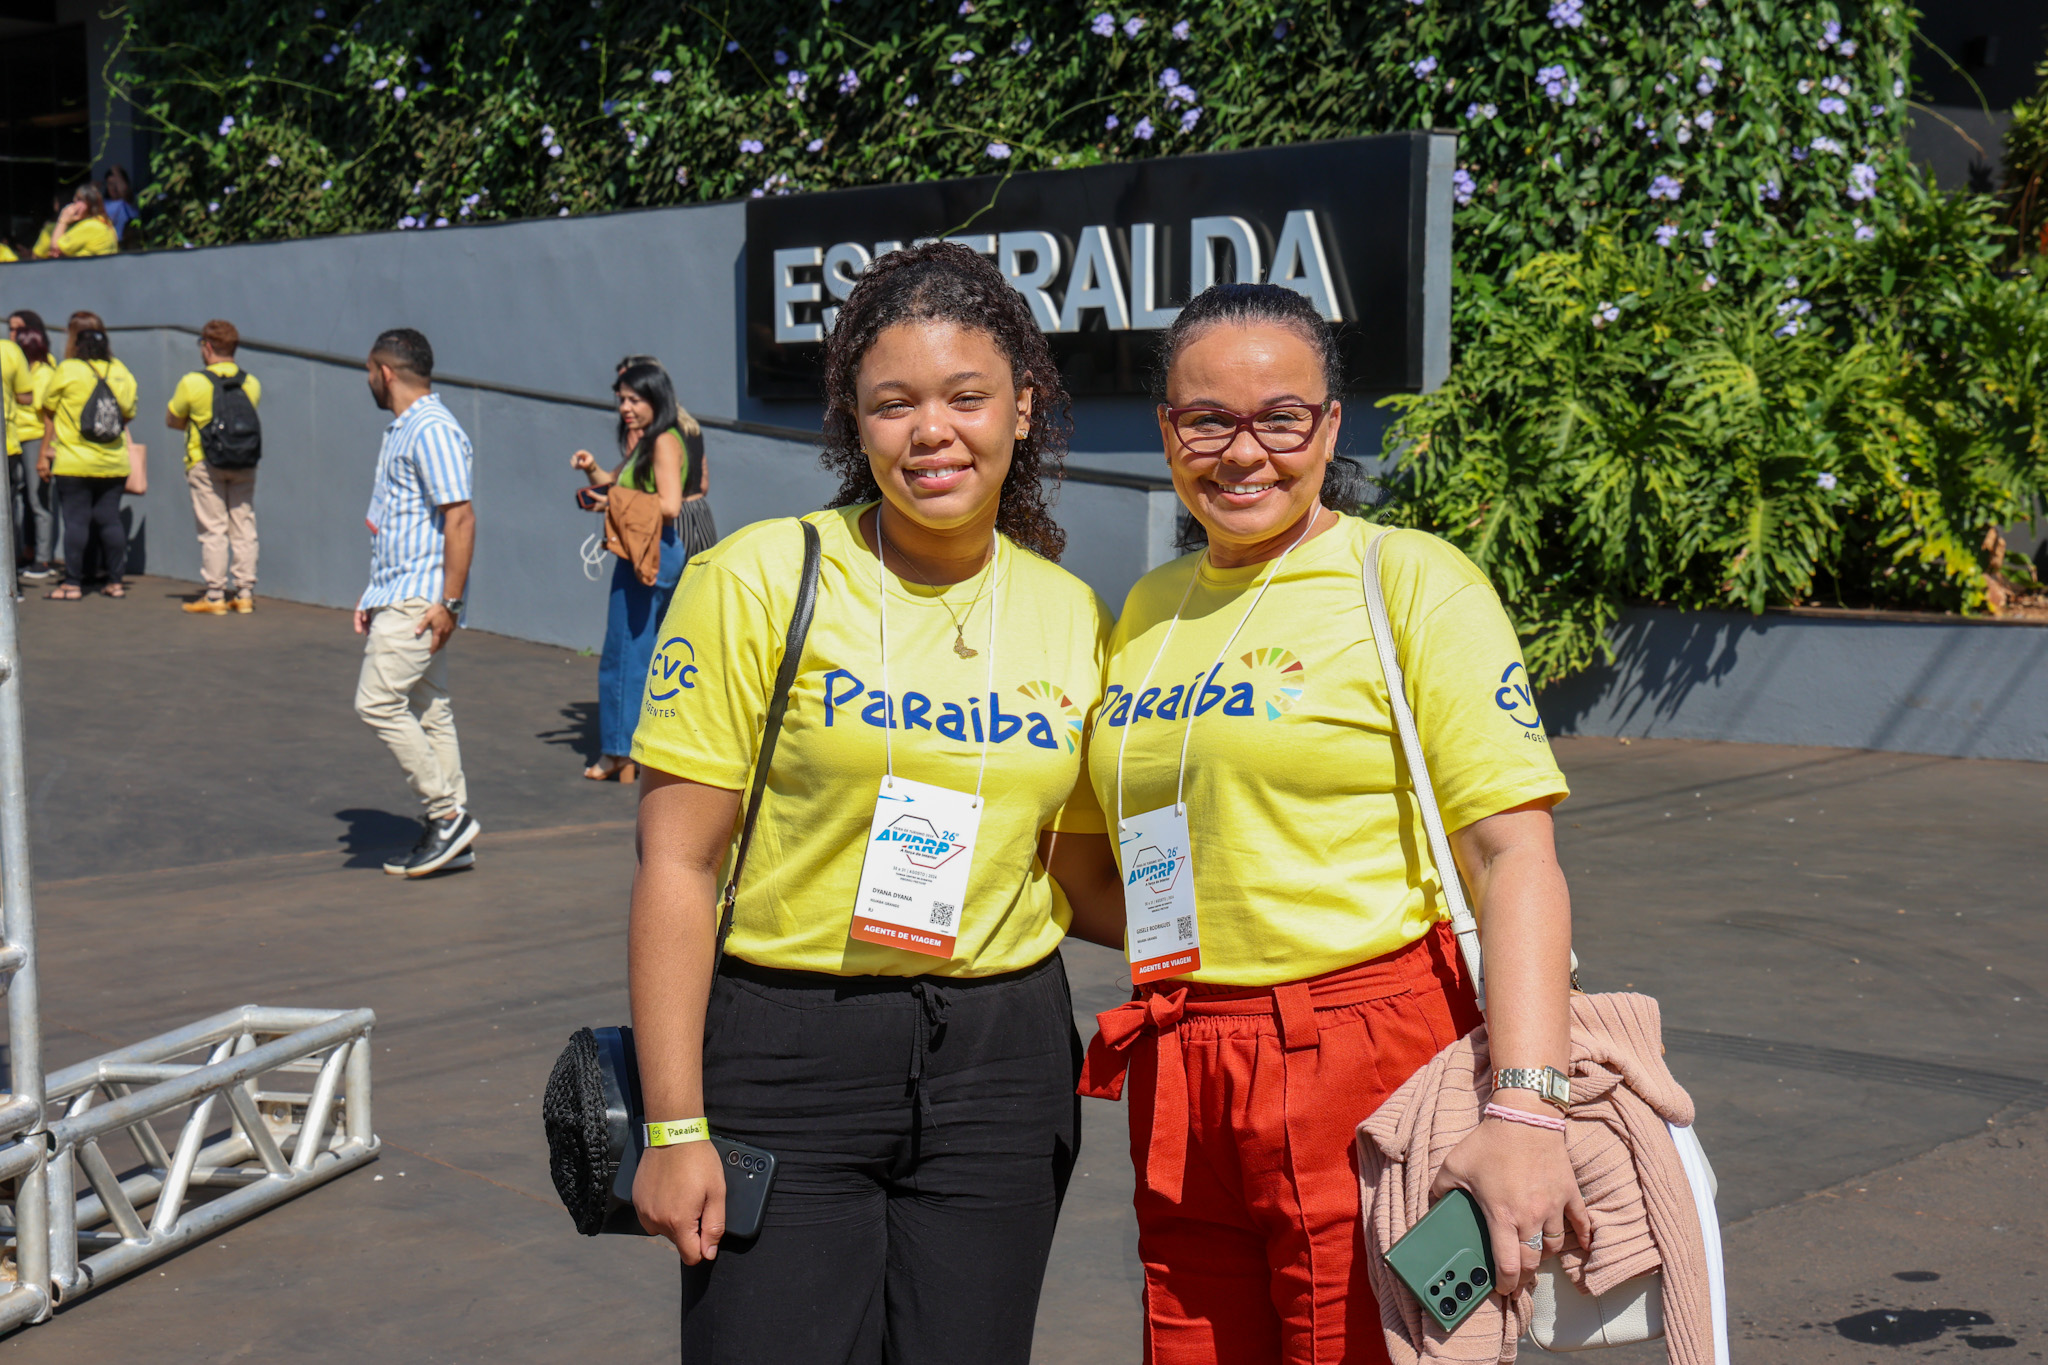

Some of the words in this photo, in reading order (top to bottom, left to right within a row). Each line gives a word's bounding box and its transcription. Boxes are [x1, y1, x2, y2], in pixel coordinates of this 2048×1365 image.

[774, 209, 1342, 343] ESRALDA
[652, 653, 698, 689] CVC
[1495, 683, 1532, 711] CV
[875, 829, 950, 855] AVIRRP
[1128, 860, 1176, 886] AVIRRP
[872, 887, 892, 897] DYANA
[893, 892, 913, 902] DYANA
[863, 924, 897, 937] AGENTE
[897, 932, 909, 940] DE
[910, 934, 942, 947] VIAGEM
[1139, 962, 1161, 974] AGENTE
[1162, 960, 1170, 969] DE
[1170, 956, 1192, 967] VIAGEM
